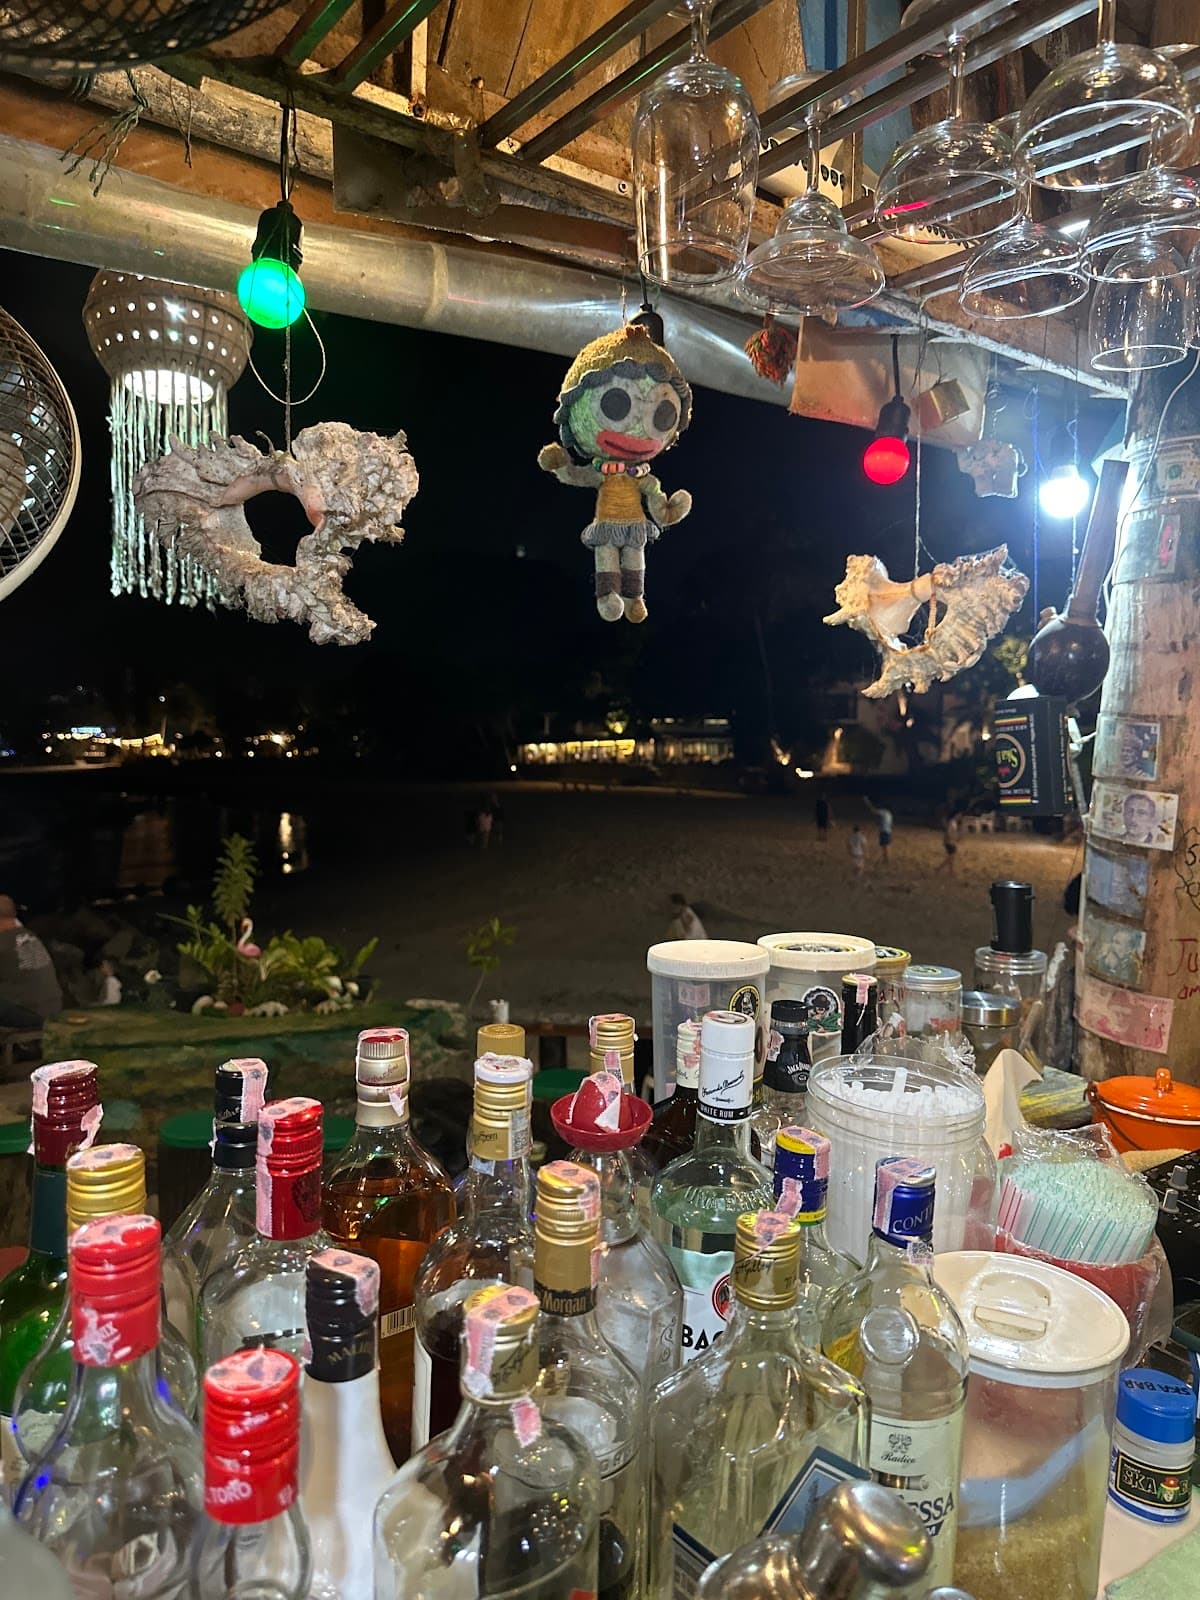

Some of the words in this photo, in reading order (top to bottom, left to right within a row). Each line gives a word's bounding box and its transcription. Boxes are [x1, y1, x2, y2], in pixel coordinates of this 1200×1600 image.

[719, 1109, 734, 1119] RUM
[542, 1290, 586, 1316] Morgan
[1124, 1379, 1156, 1391] BAR
[1158, 1383, 1192, 1396] SKA
[880, 1452, 917, 1464] Radico
[1122, 1468, 1157, 1495] SKA
